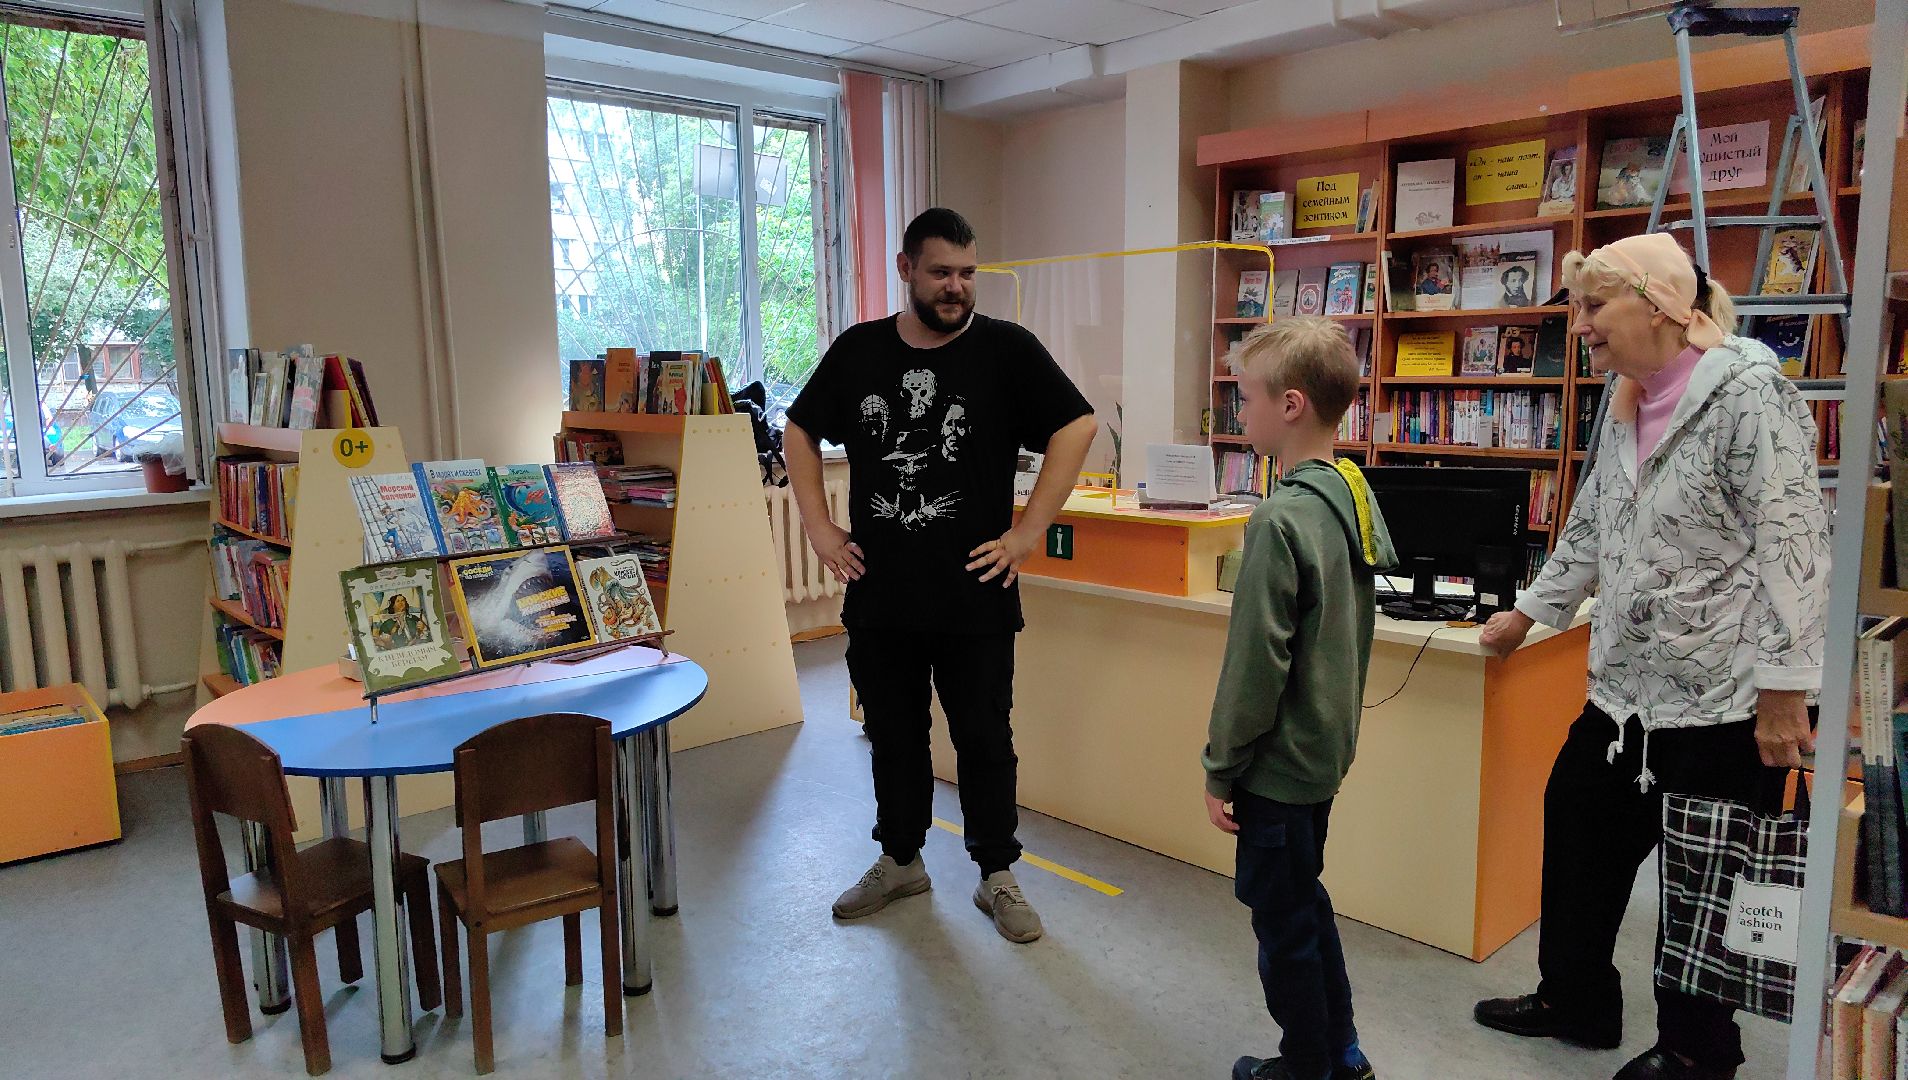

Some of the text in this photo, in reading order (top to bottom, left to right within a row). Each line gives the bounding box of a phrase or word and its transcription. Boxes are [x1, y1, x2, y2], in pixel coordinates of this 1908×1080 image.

[1710, 132, 1738, 147] Мой
[1497, 156, 1514, 164] наш
[1699, 145, 1761, 167] ушистый
[1497, 169, 1519, 178] наша
[1708, 166, 1742, 183] друг
[1316, 180, 1337, 192] Под
[1302, 196, 1350, 209] семейным
[1303, 210, 1349, 222] зонтиком
[340, 438, 369, 457] 0+
[1739, 901, 1784, 919] Scotch
